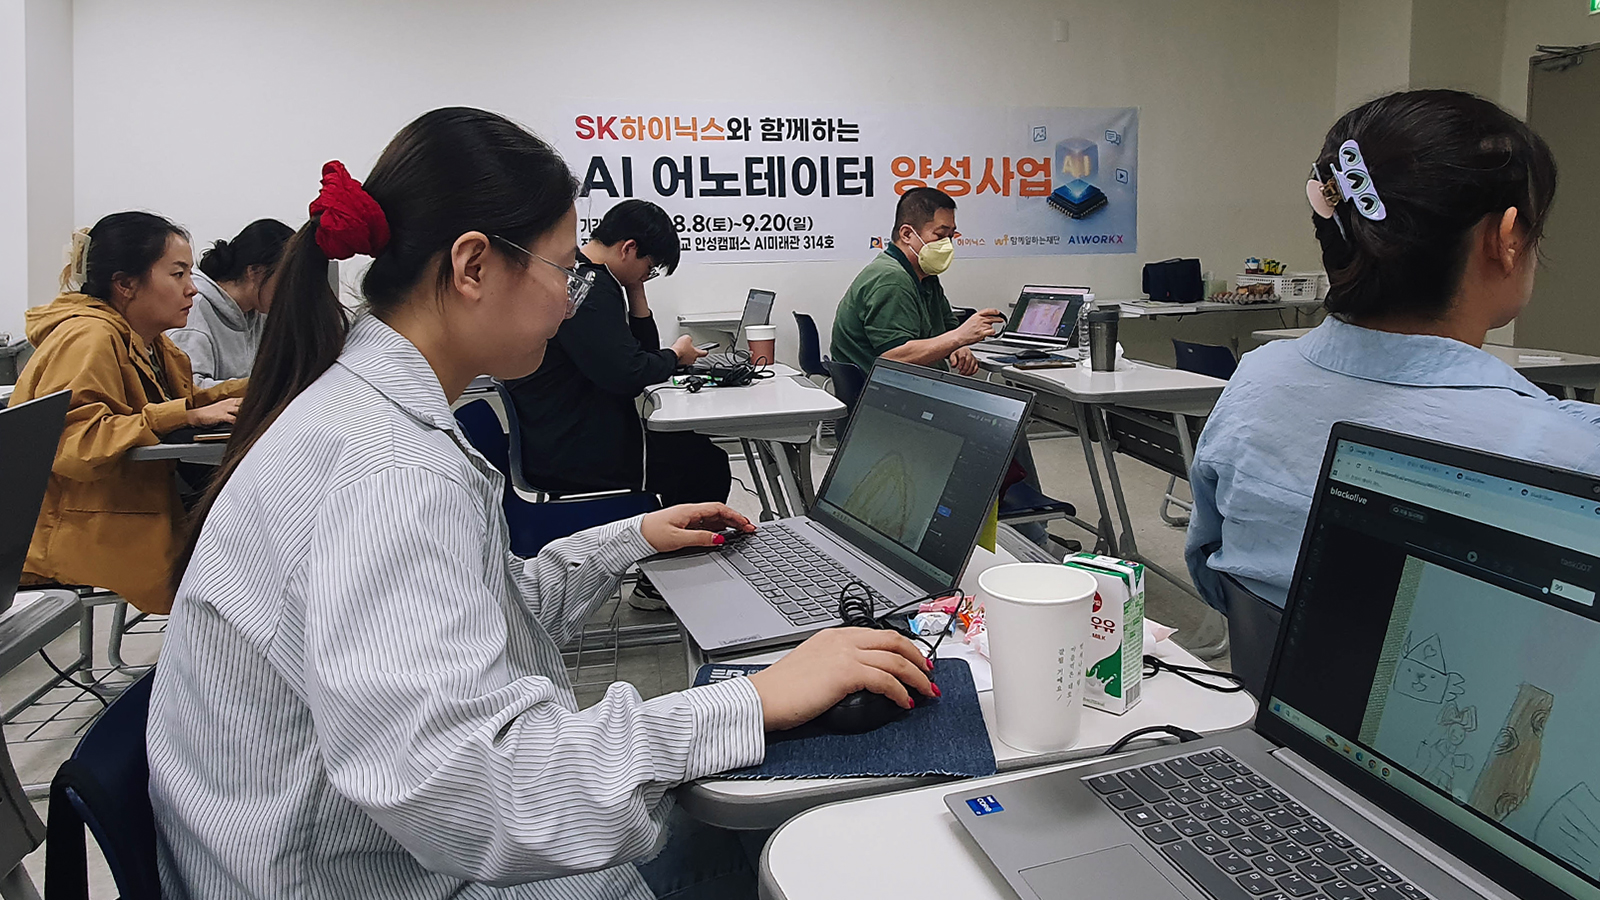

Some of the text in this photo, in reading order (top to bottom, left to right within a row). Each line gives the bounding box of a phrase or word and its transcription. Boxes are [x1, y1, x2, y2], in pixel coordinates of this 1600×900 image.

[574, 115, 859, 143] SK하이닉스와 함께하는
[579, 155, 1052, 199] AI 어노테이터 양성사업
[1062, 154, 1091, 178] AI
[694, 236, 751, 251] 안성캠퍼스
[754, 235, 801, 250] AI미래관
[803, 235, 835, 249] 314호
[1091, 616, 1115, 634] 우유
